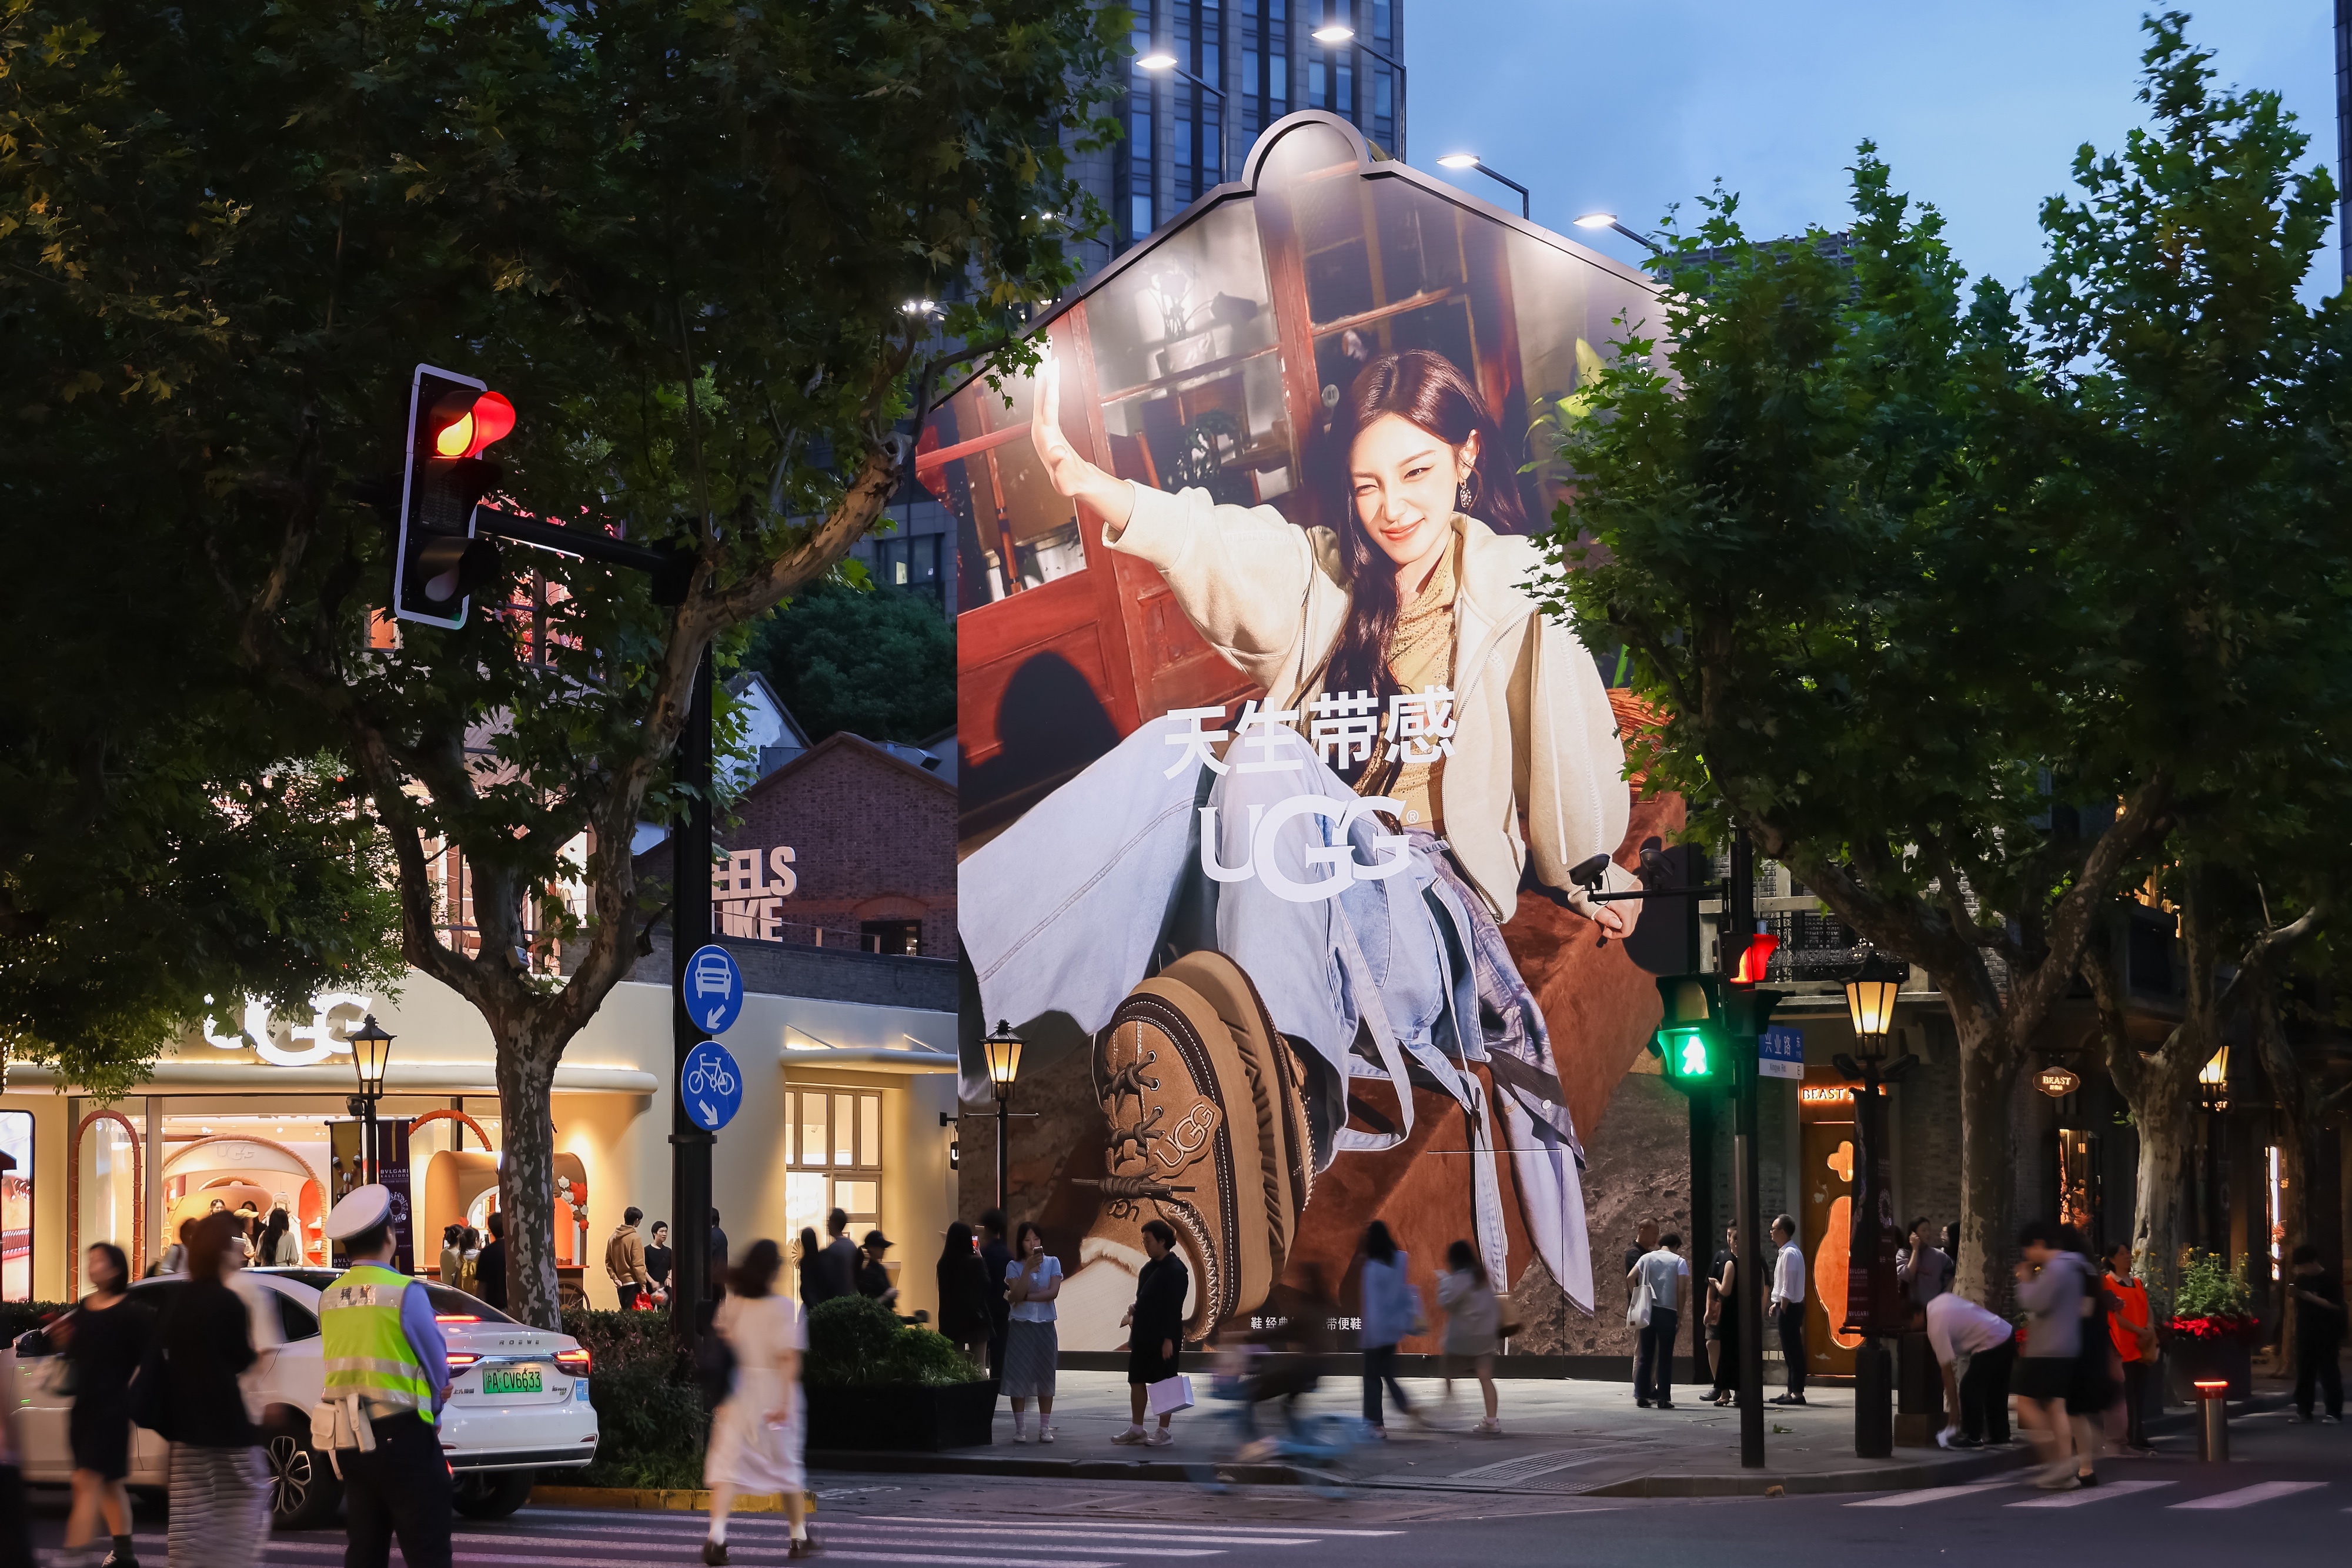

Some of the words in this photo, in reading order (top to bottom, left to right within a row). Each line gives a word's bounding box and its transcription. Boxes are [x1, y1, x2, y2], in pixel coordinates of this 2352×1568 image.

[1162, 684, 1456, 780] 天生带感
[1198, 794, 1412, 902] UGG
[712, 897, 783, 942] IKE
[1765, 1032, 1791, 1056] 兴业路
[1797, 1065, 1800, 1075] E
[2042, 1076, 2071, 1085] BEAST
[1803, 1088, 1846, 1100] BEAST
[1154, 1101, 1215, 1168] UGG
[216, 1144, 256, 1161] UGG
